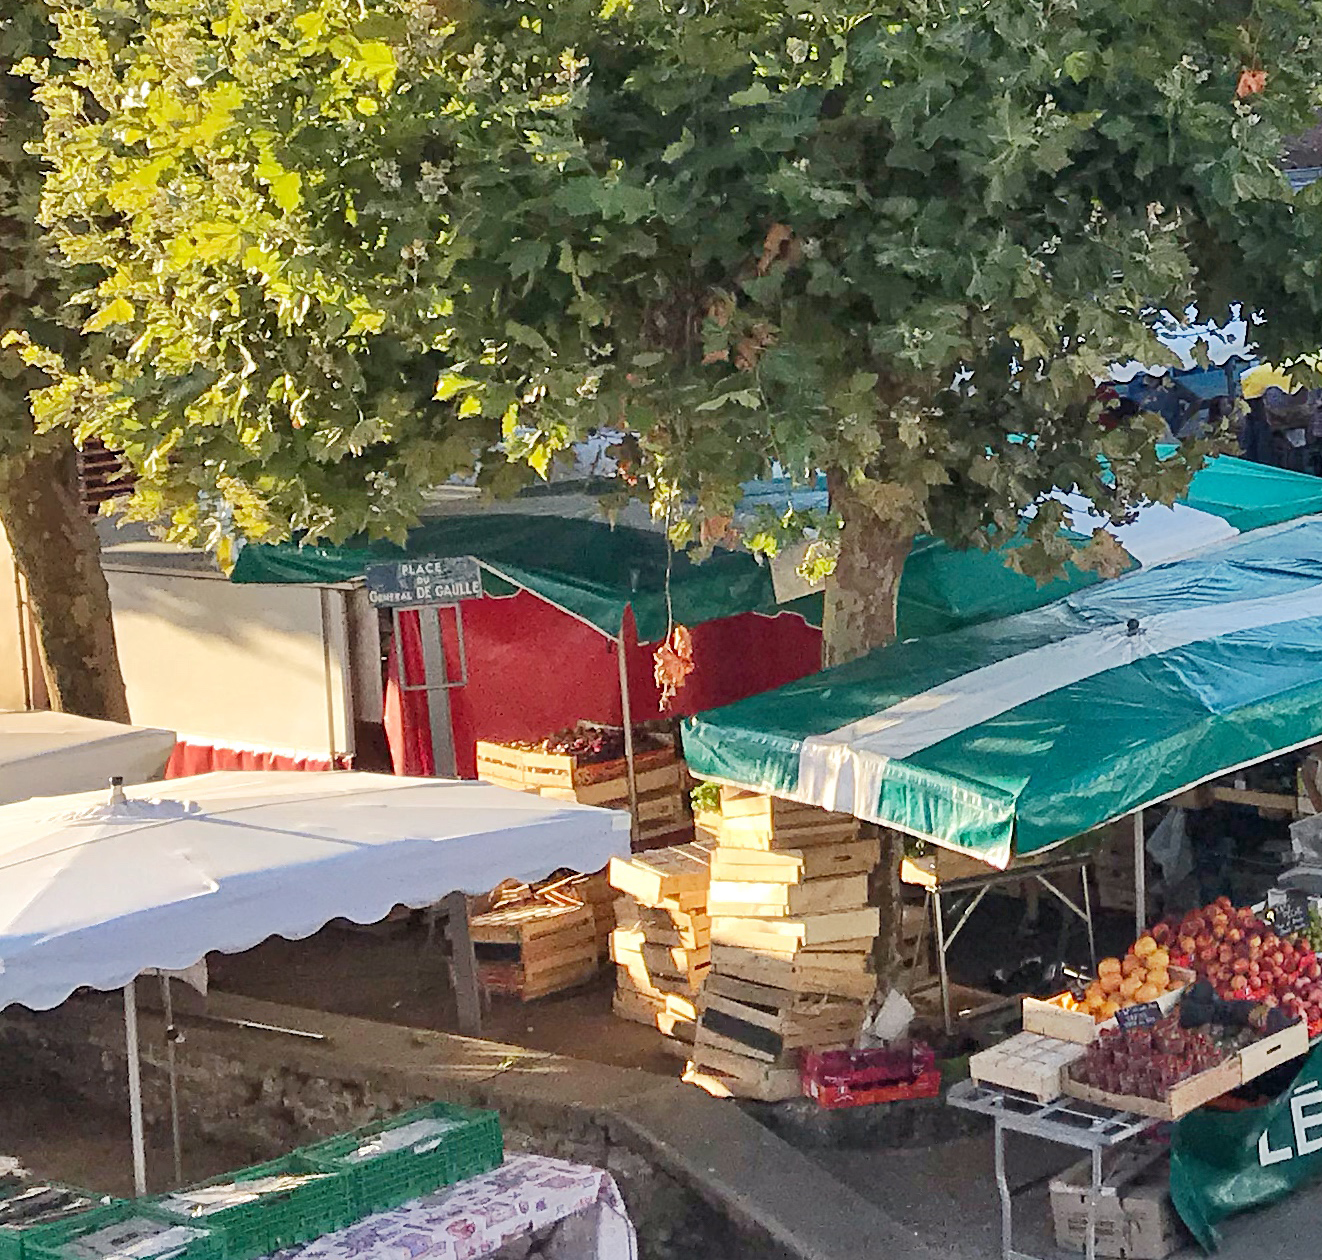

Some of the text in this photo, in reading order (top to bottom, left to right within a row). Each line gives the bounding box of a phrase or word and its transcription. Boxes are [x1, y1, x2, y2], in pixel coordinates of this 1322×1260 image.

[401, 562, 442, 576] PLACE
[416, 576, 430, 585] DU
[416, 586, 432, 600] DE
[434, 581, 480, 598] GAULLE
